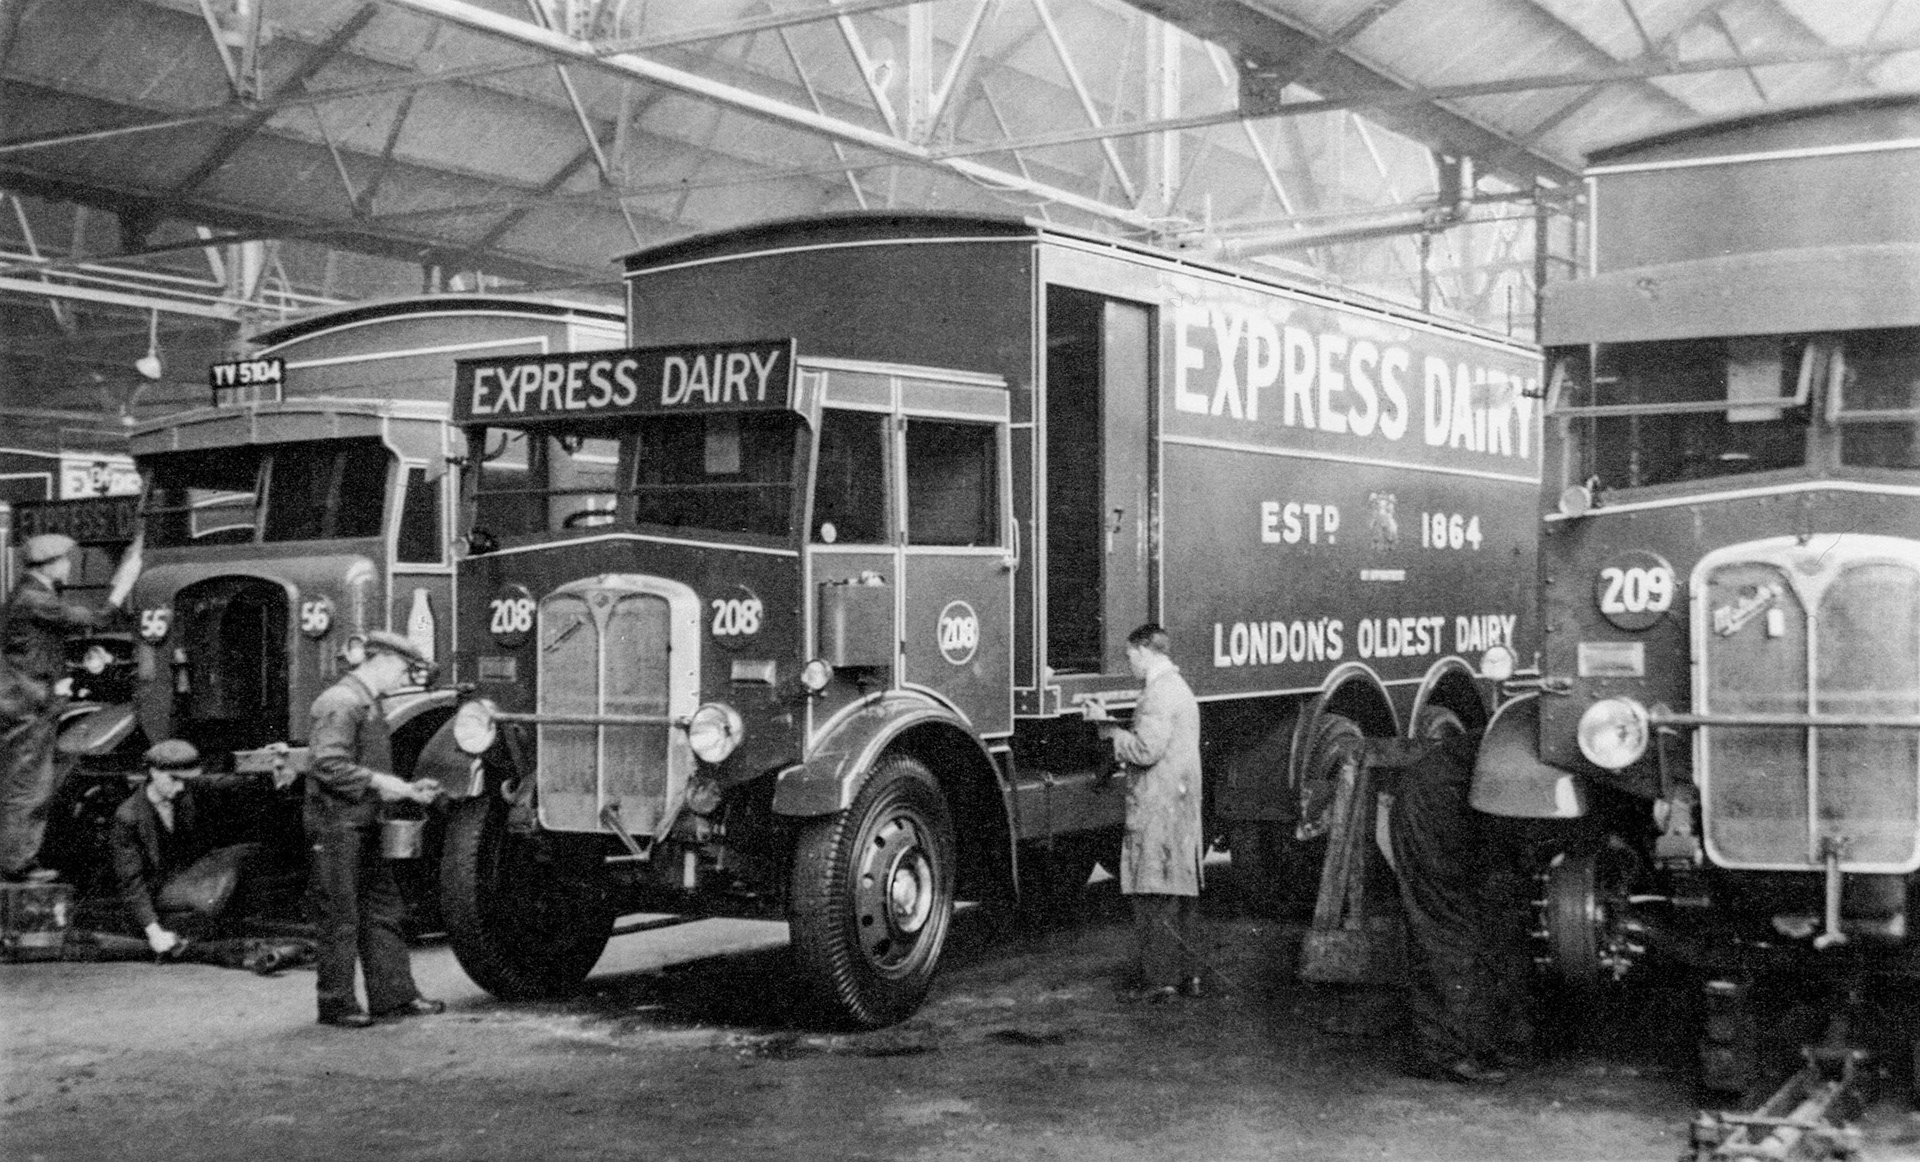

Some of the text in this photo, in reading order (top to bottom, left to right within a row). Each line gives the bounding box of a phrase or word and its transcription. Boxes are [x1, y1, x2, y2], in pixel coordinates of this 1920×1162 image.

[472, 350, 780, 414] EXPRESS DAIRY
[1175, 306, 1537, 459] EXPRESS DAIRY
[1422, 511, 1483, 550] 1864
[1601, 567, 1673, 613] 209
[141, 609, 169, 638] 56
[301, 601, 329, 631] 56
[489, 598, 532, 634] 208
[711, 599, 761, 636] 208
[941, 616, 975, 650] 208
[1213, 614, 1517, 667] LONDON'S OLDEST DAIRY
